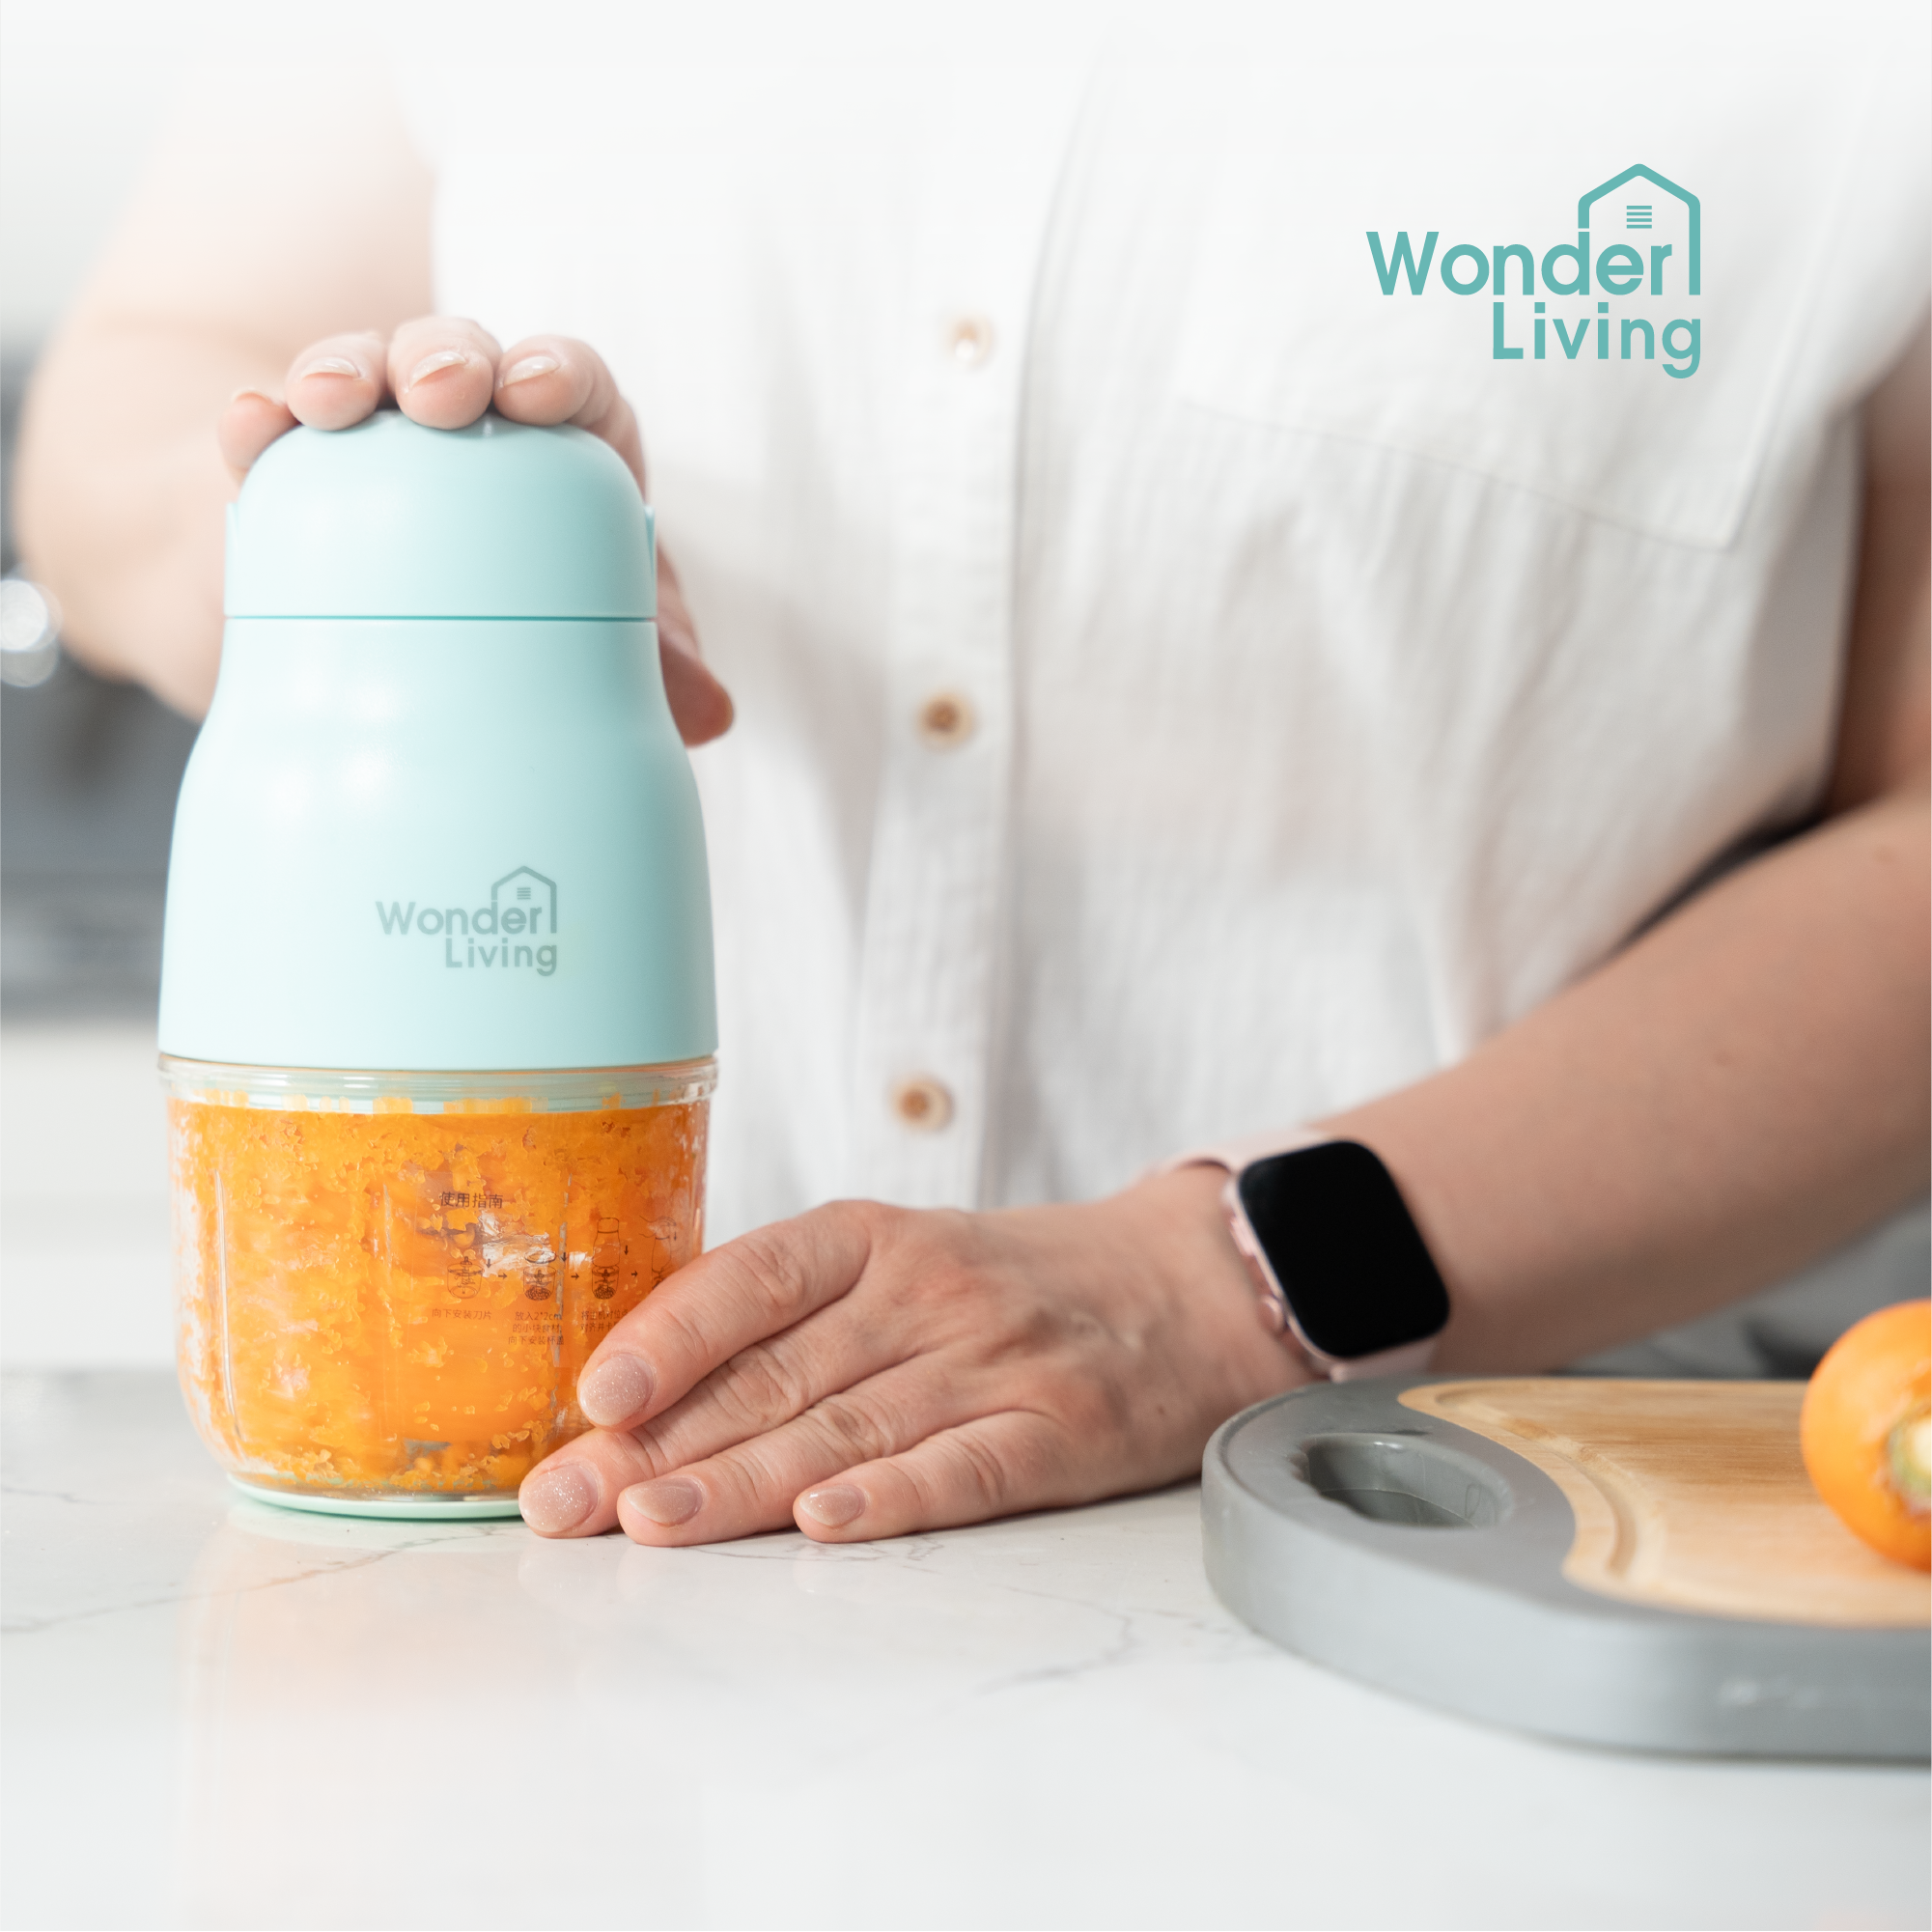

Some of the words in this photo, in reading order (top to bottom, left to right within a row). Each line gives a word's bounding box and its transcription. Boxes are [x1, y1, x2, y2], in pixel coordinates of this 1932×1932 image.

[375, 901, 543, 936] Wonder
[445, 938, 558, 977] Living
[440, 1190, 503, 1209] 使用指南
[432, 1307, 492, 1321] 向下安装刀片
